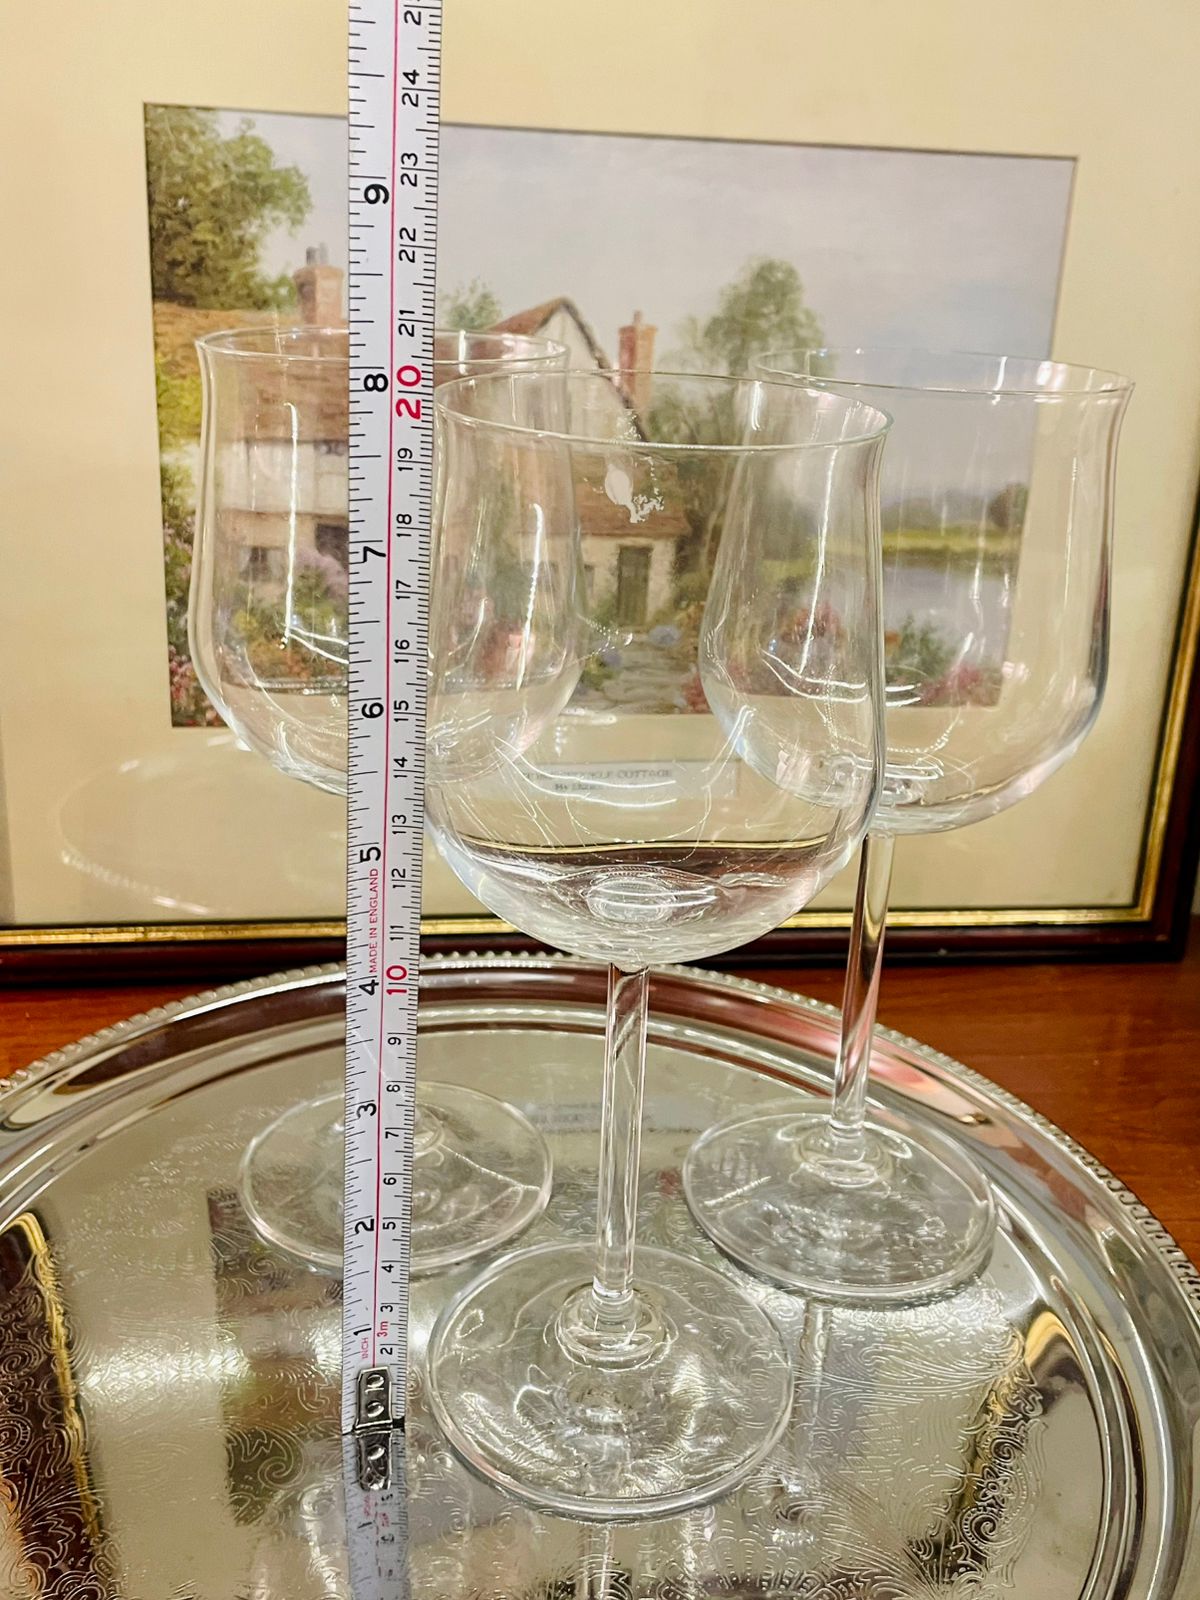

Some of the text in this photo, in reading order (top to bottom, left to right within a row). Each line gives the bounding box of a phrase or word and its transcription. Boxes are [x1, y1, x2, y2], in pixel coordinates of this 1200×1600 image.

[403, 0, 422, 26] 2
[401, 69, 420, 108] 24
[400, 152, 419, 188] 23
[363, 183, 390, 205] 9
[398, 227, 417, 264] 22
[398, 309, 416, 338] 21
[363, 373, 389, 393] 8
[395, 365, 422, 420] 20
[397, 447, 413, 472] 19
[396, 513, 412, 538] 18
[363, 545, 387, 564] 7
[395, 579, 412, 600] 17
[393, 639, 410, 664] 16
[361, 702, 384, 719] 6
[393, 700, 409, 723] 15
[393, 756, 409, 779] 14
[391, 814, 407, 835] 13
[359, 846, 382, 863] 5
[391, 868, 406, 889] 12
[368, 868, 379, 974] MADE IN ENGLAND
[389, 925, 404, 941] 11
[358, 979, 380, 996] 4
[385, 965, 408, 996] 10
[387, 1036, 402, 1046] 9
[386, 1084, 400, 1093] 8
[356, 1102, 377, 1119] 3
[384, 1131, 399, 1139] 7
[382, 1177, 397, 1186] 6
[354, 1219, 375, 1234] 2
[382, 1221, 396, 1230] 5
[381, 1264, 394, 1273] 4
[380, 1304, 393, 1313] 3
[353, 1327, 372, 1337] 1
[376, 1321, 389, 1338] 3m
[361, 1337, 369, 1360] INCH
[380, 1347, 393, 1356] 2
